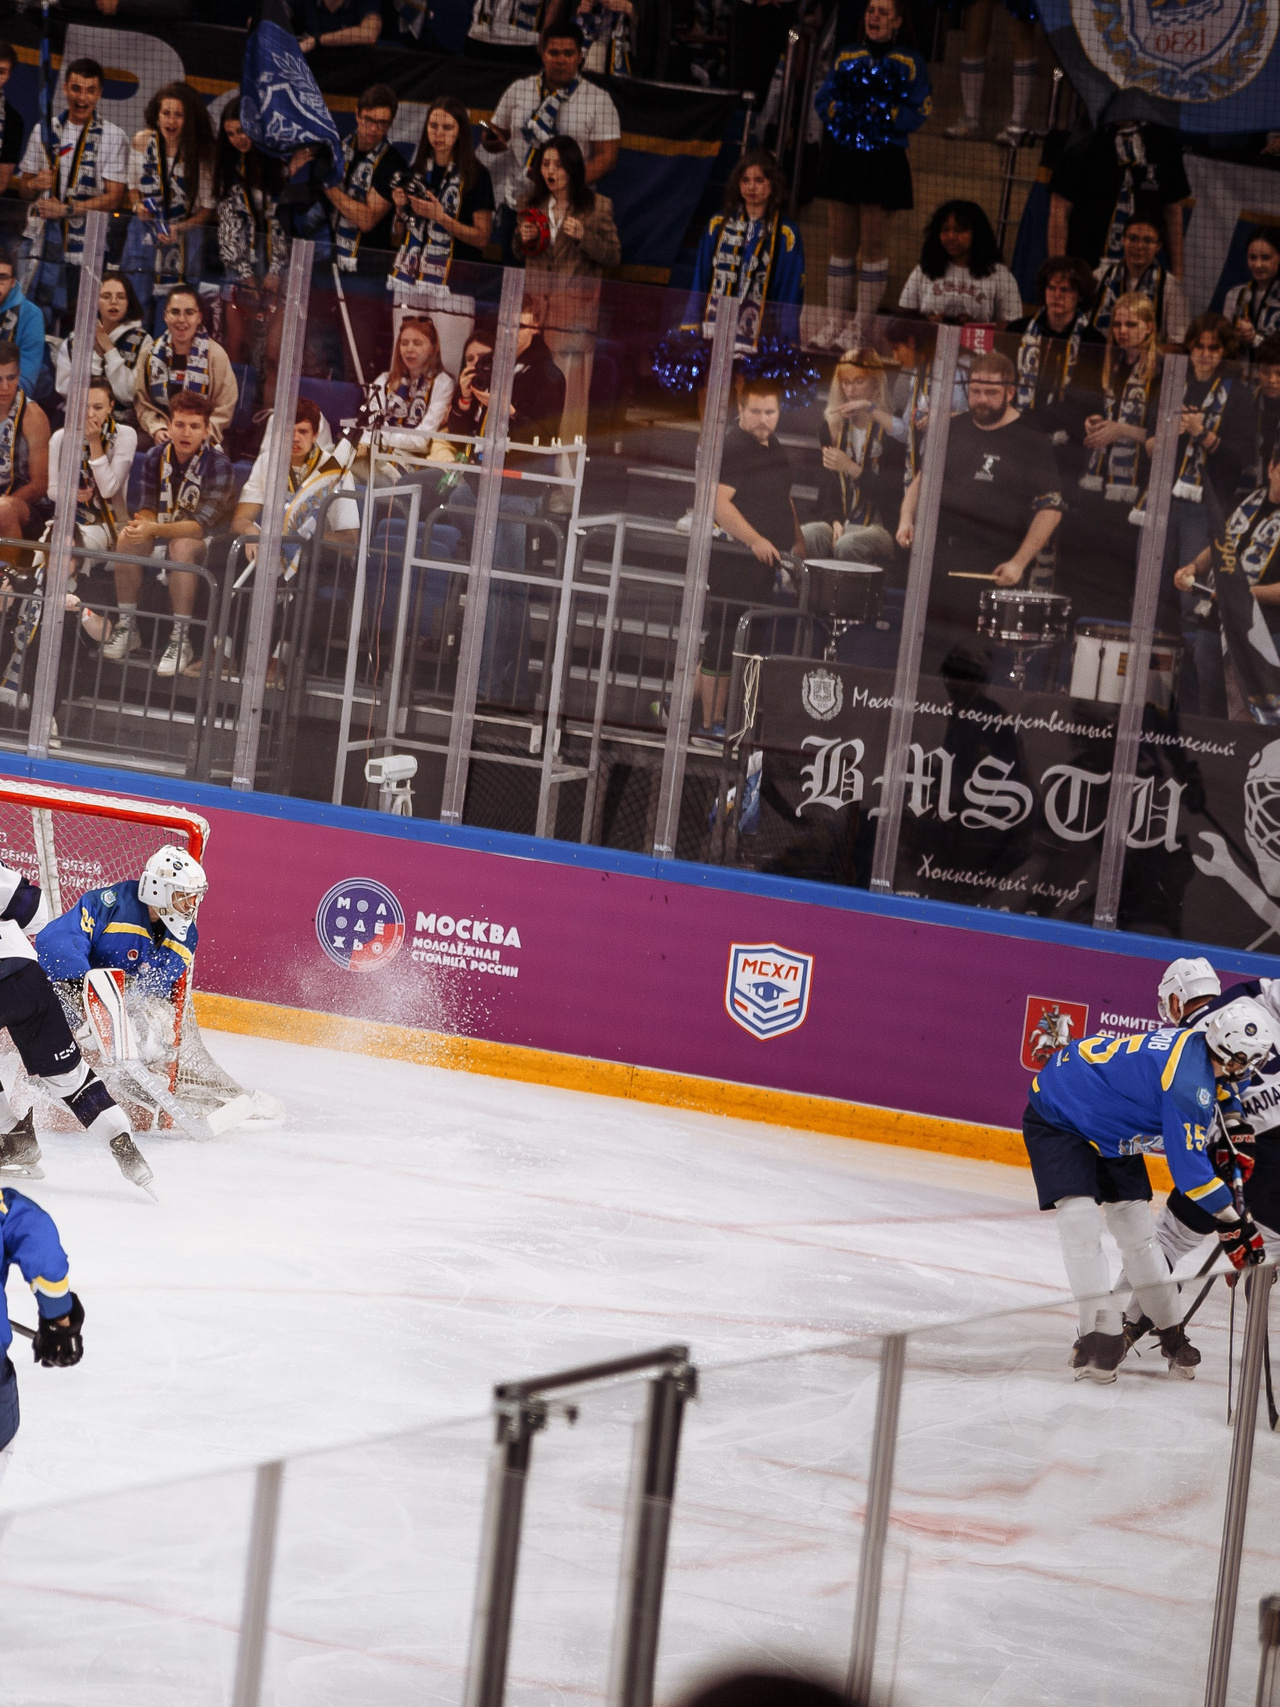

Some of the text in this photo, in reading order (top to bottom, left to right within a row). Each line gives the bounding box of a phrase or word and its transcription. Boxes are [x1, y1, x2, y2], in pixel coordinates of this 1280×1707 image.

[917, 854, 1030, 892] Хоккейный
[1032, 879, 1088, 908] клуб
[415, 911, 521, 948] МОСКВА
[412, 937, 500, 962] МОЛОДЁЖНАЯ
[411, 951, 467, 970] СТОЛИЦА
[470, 960, 519, 978] РОССИИ
[741, 958, 799, 981] МСХЛ
[1100, 1012, 1164, 1031] КОМИТЕТ
[1183, 1122, 1207, 1151] 15
